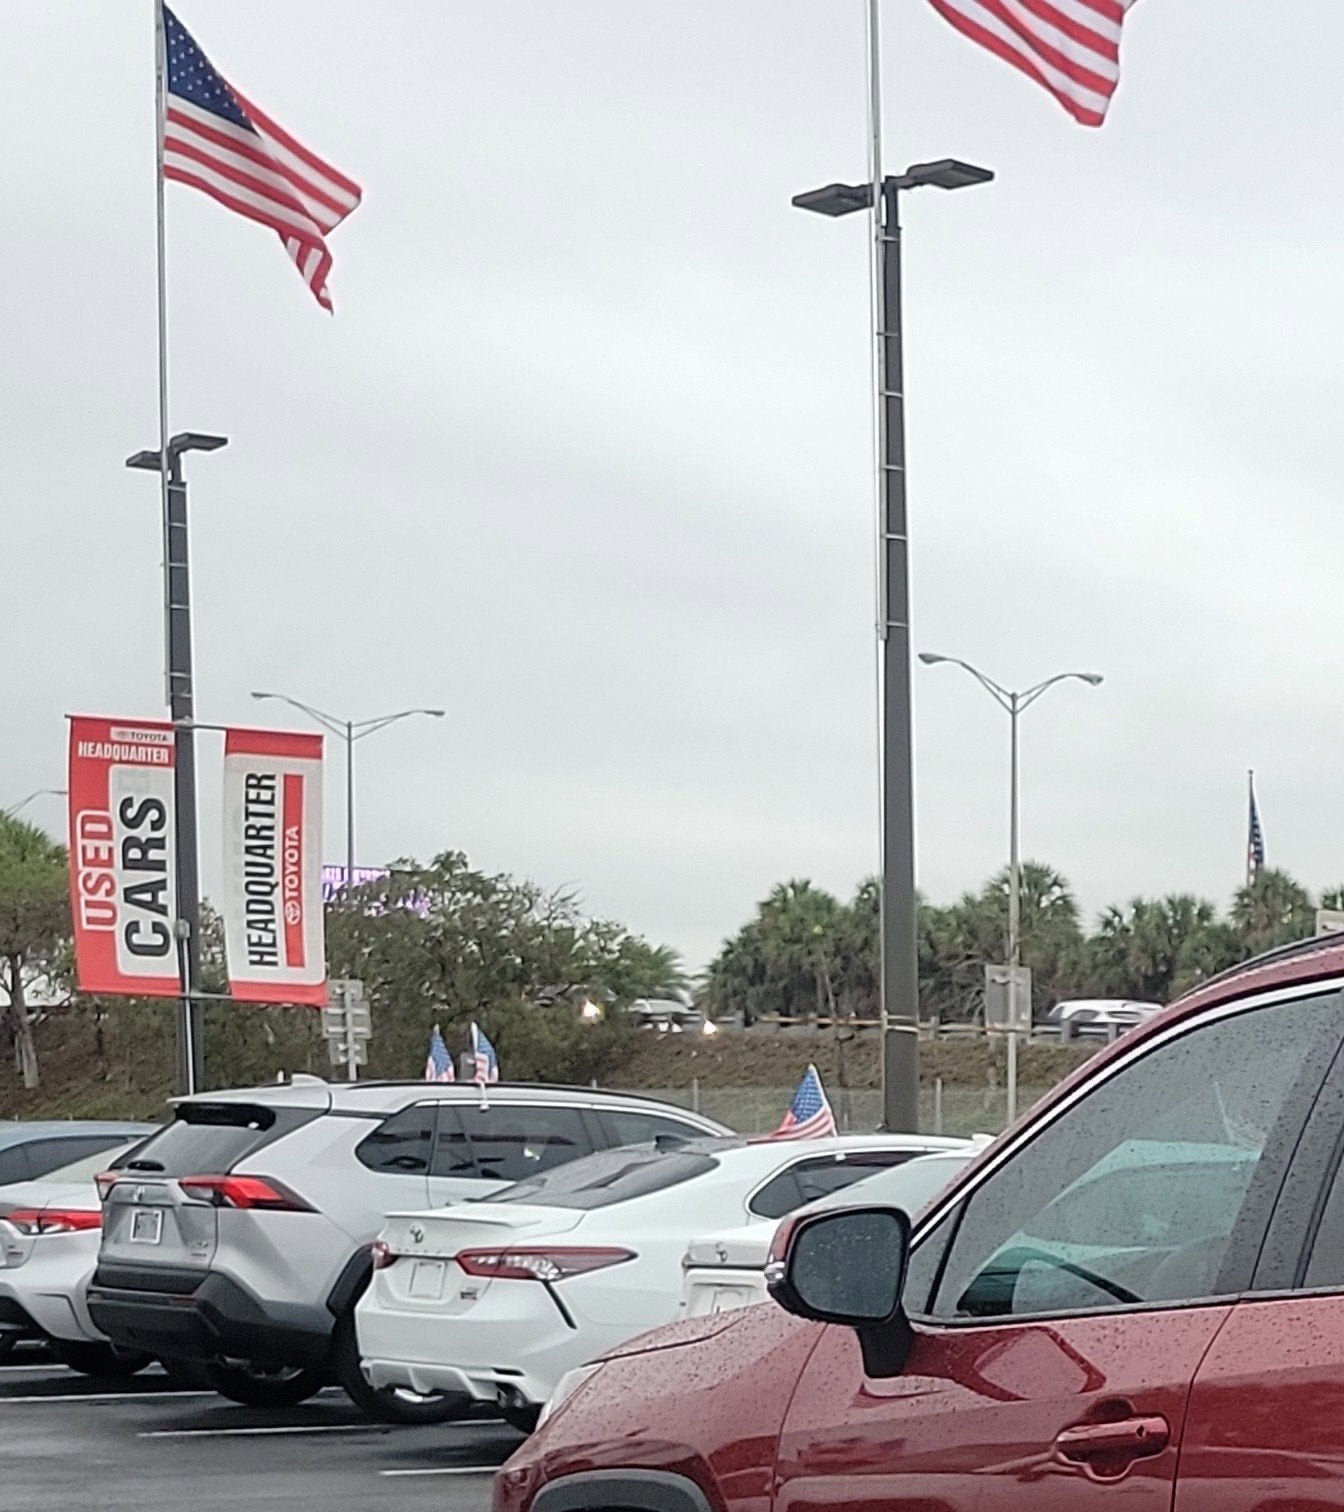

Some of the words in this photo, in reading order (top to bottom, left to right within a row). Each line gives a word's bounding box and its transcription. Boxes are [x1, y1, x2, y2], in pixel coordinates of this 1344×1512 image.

[78, 741, 169, 764] HEADQUARTER
[131, 731, 168, 741] TOYOTA
[77, 810, 117, 930] USED
[118, 795, 172, 958] CARS
[244, 771, 279, 967] HEADQUARTER
[285, 825, 300, 899] TOYOTA
